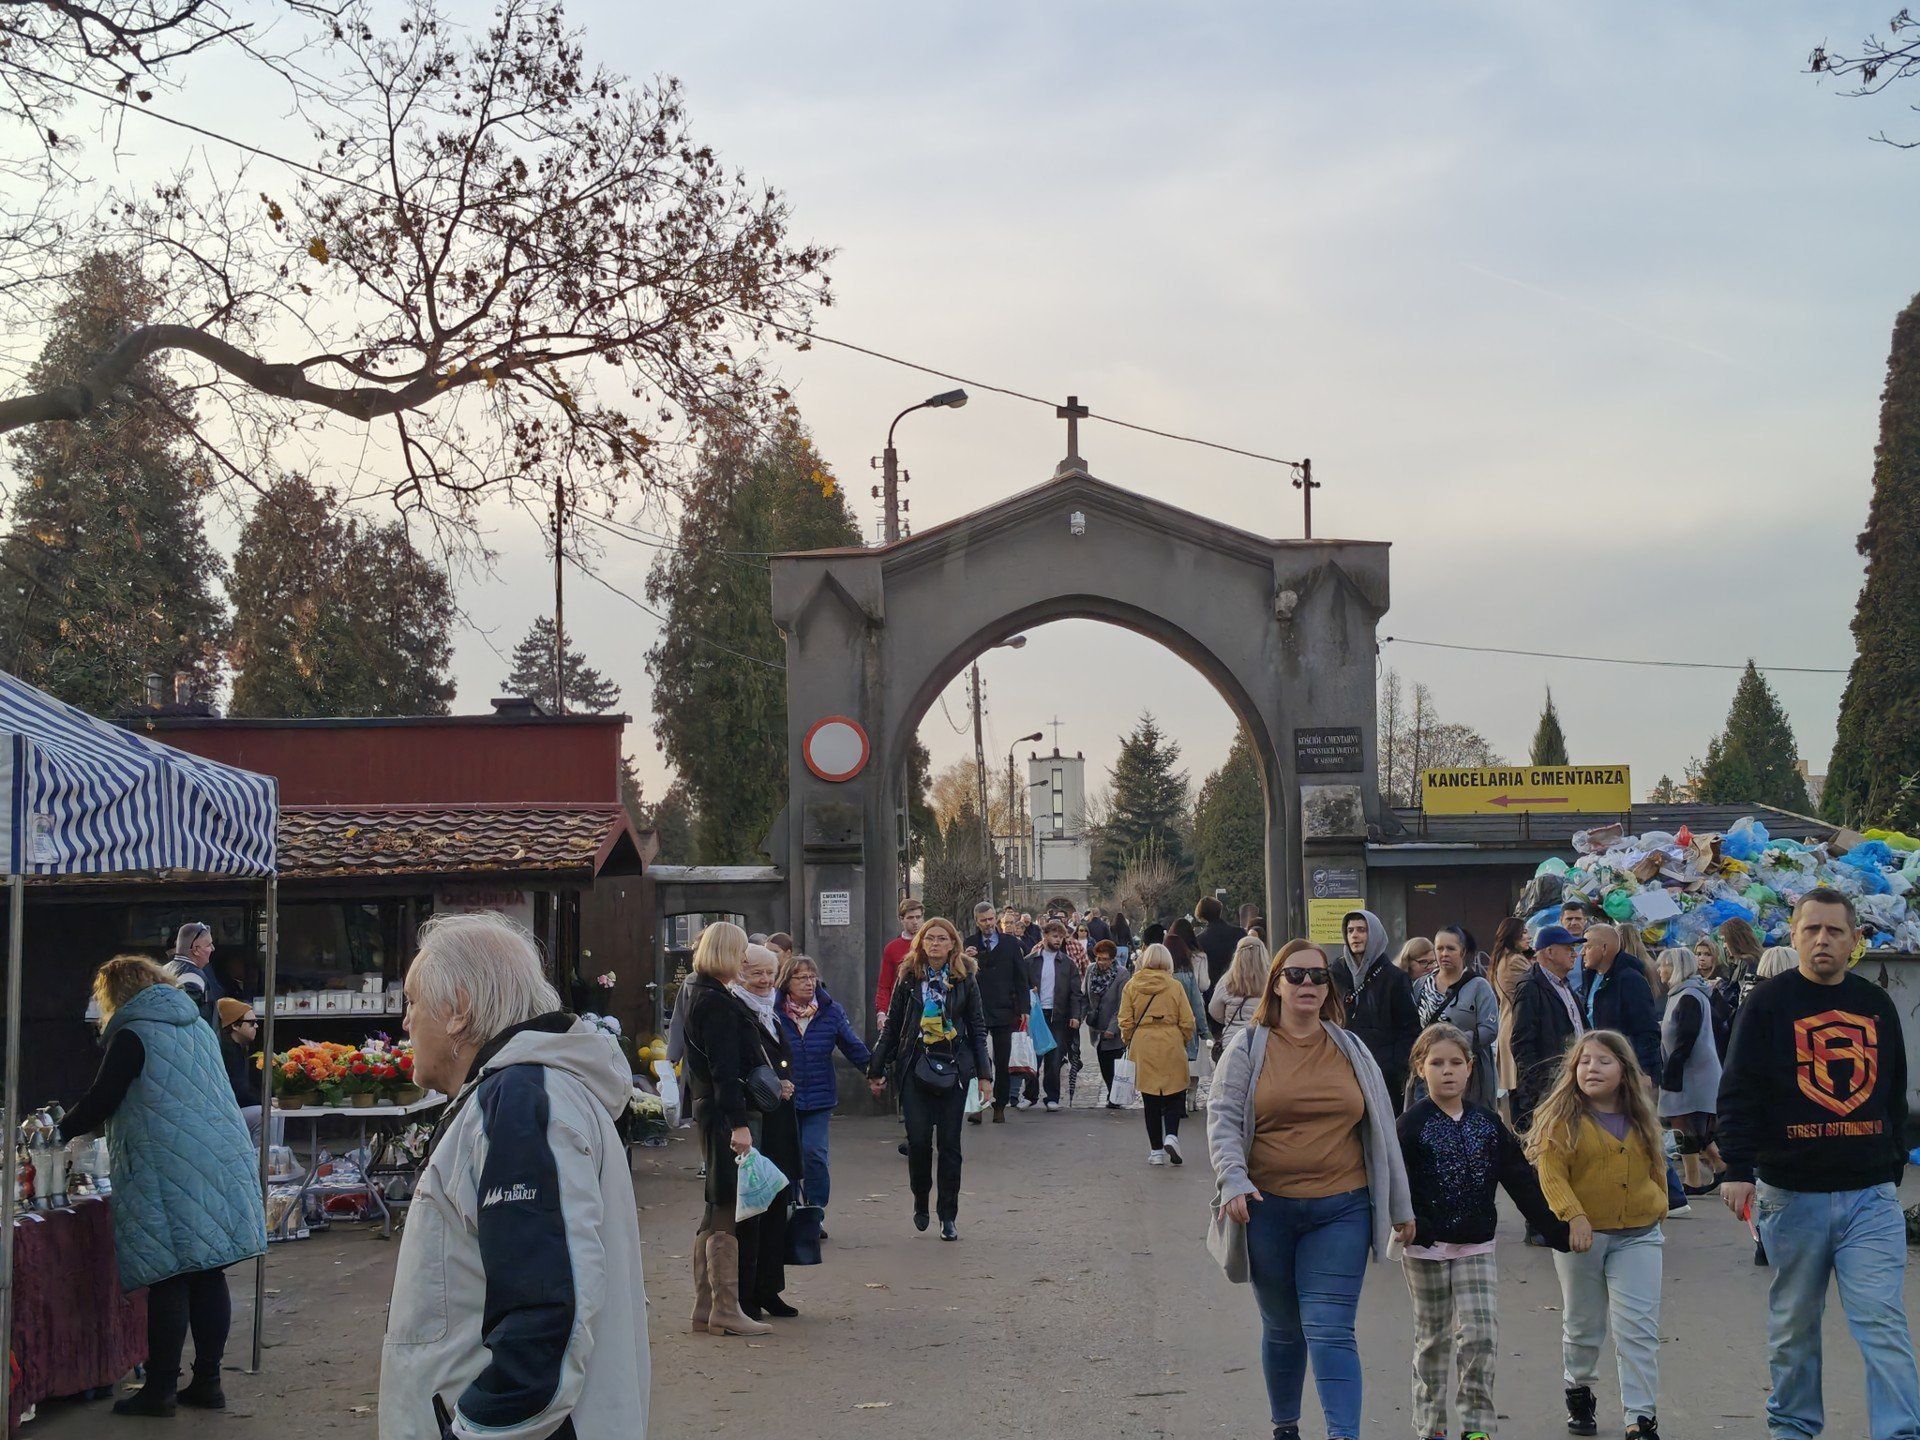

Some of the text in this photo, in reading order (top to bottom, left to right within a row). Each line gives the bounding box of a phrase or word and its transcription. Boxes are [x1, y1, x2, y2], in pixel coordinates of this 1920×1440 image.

[1428, 770, 1624, 787] KANCELARIA CMENTARZA
[503, 1189, 537, 1201] TABARLY
